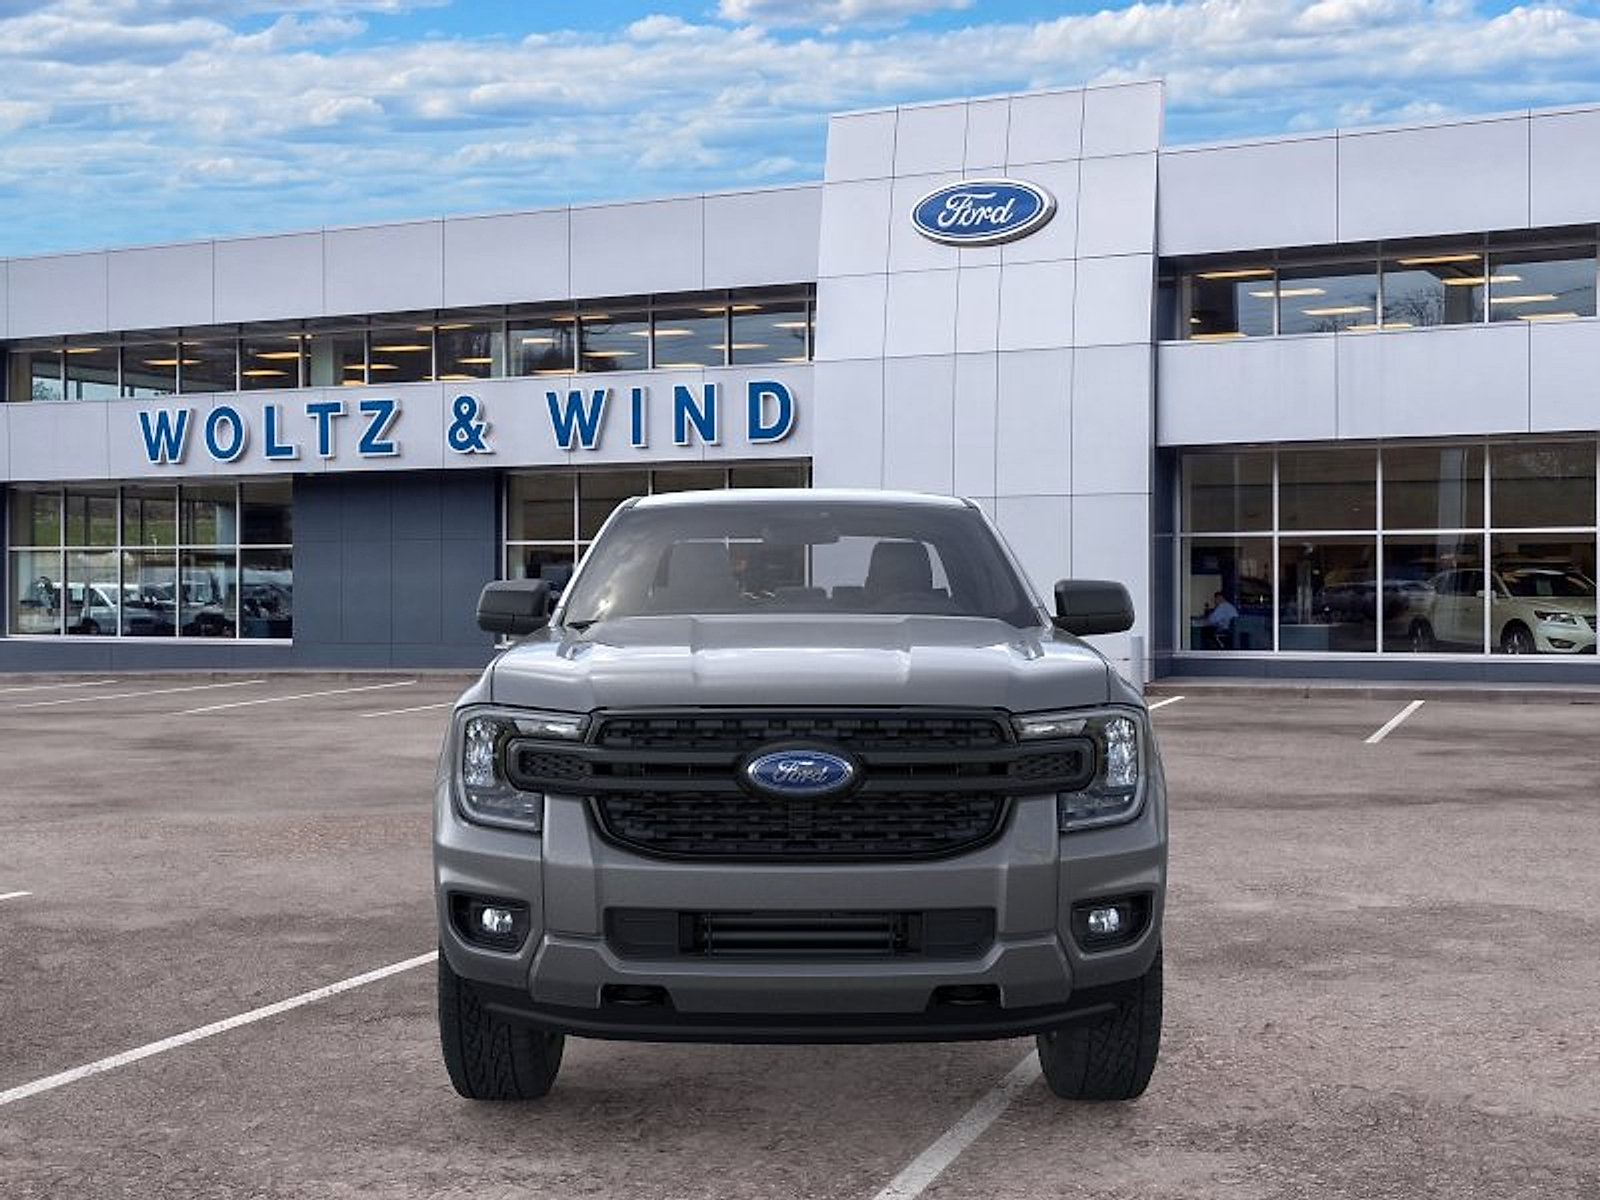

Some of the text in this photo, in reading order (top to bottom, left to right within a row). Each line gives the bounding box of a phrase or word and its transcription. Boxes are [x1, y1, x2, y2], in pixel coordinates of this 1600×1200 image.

[938, 192, 1015, 227] Ford
[139, 380, 796, 464] WOLTZ & WIND
[773, 760, 829, 782] Ford
